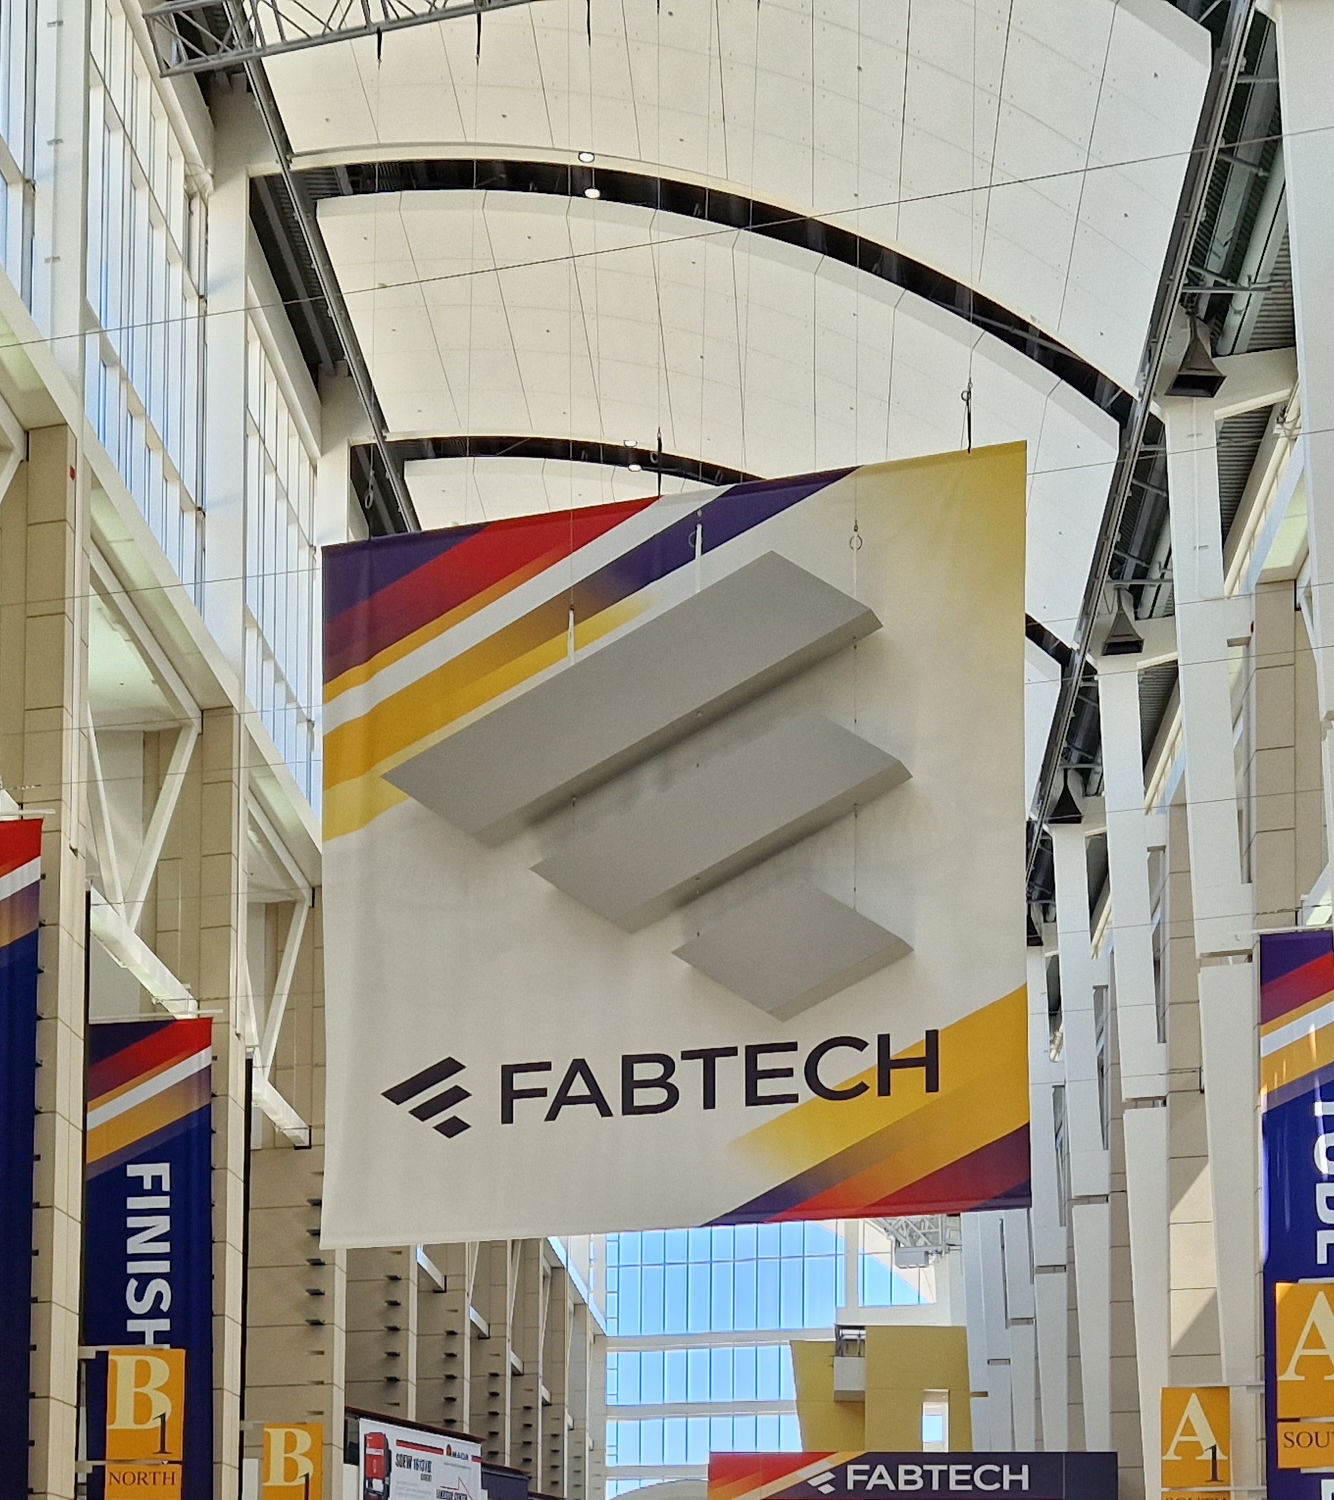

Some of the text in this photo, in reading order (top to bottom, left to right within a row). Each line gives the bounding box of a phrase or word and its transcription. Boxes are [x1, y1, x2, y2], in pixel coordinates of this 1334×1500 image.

[500, 1028, 941, 1125] FABTECH
[108, 1469, 177, 1488] NORTH
[846, 1464, 1031, 1492] FABTECH
